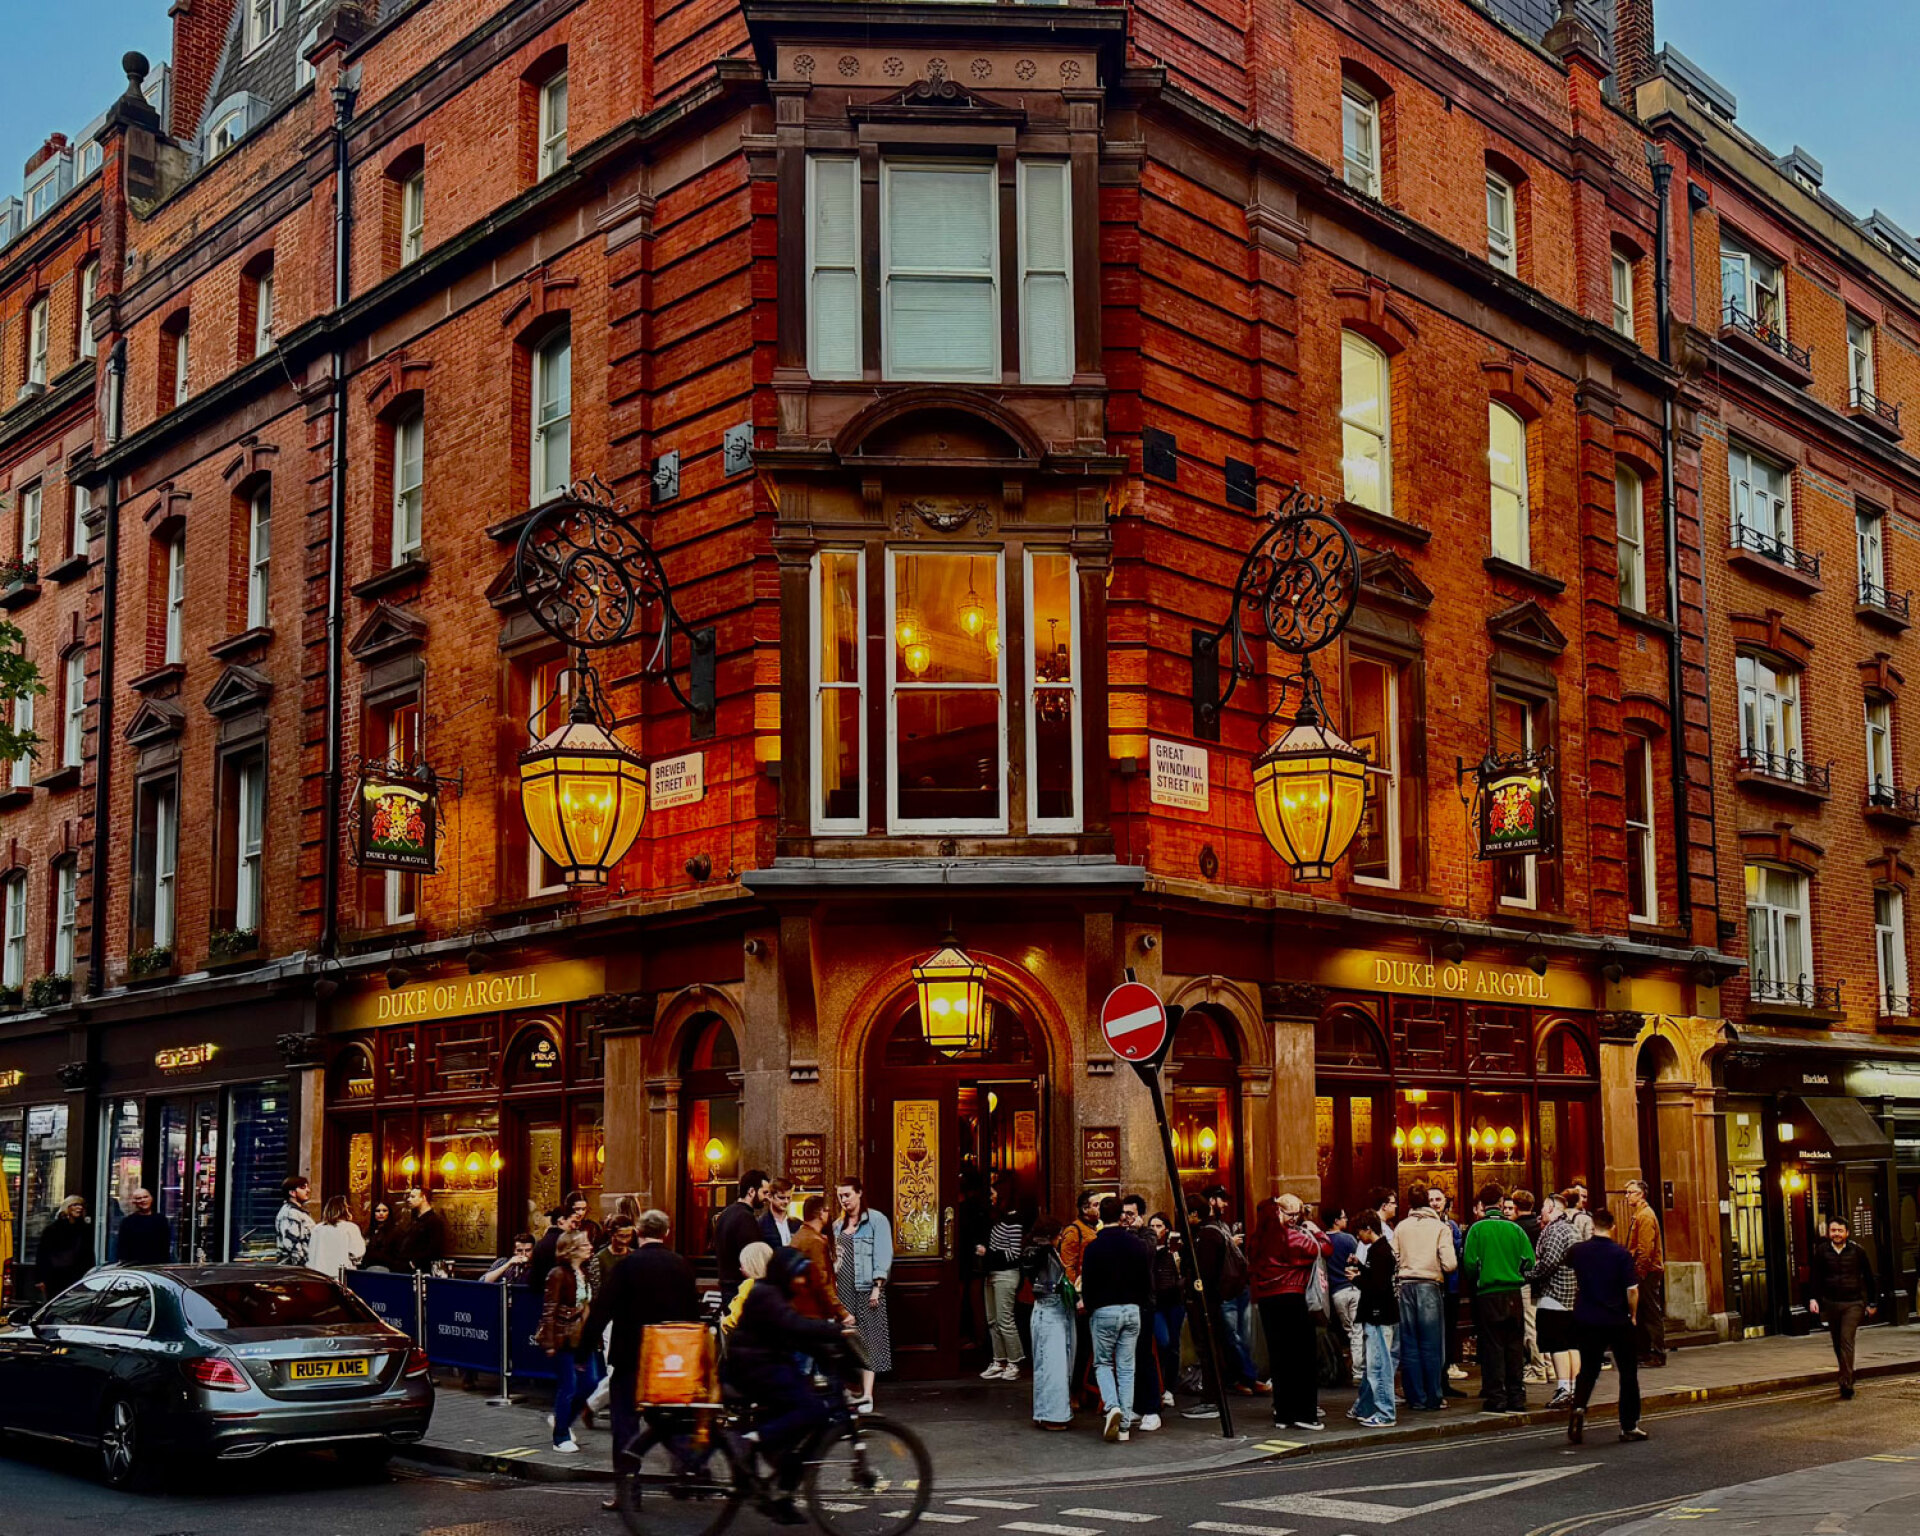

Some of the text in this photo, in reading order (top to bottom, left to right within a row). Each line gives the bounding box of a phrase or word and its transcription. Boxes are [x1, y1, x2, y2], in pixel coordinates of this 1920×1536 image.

[1156, 744, 1184, 761] GREAT
[655, 761, 686, 779] BREWER
[1157, 759, 1202, 780] WINDMILL
[655, 773, 697, 794] STREET W1
[1156, 775, 1204, 795] STREET W1
[1485, 842, 1502, 851] DUKE
[1514, 838, 1539, 847] ARGYLL
[365, 851, 386, 860] DUKE
[400, 856, 429, 865] ARGYLL
[1375, 959, 1549, 999] DUKE OF ARGYLL
[376, 973, 541, 1019] DUKE OF ARGYLL
[1736, 1126, 1751, 1147] 25
[791, 1148, 820, 1157] FOOD
[1087, 1141, 1114, 1149] FOOD
[1799, 1150, 1832, 1158] Blacklock
[455, 1311, 472, 1322] FOOD
[439, 1325, 489, 1340] SERVED UPSTAIRS
[296, 1362, 334, 1377] RU57
